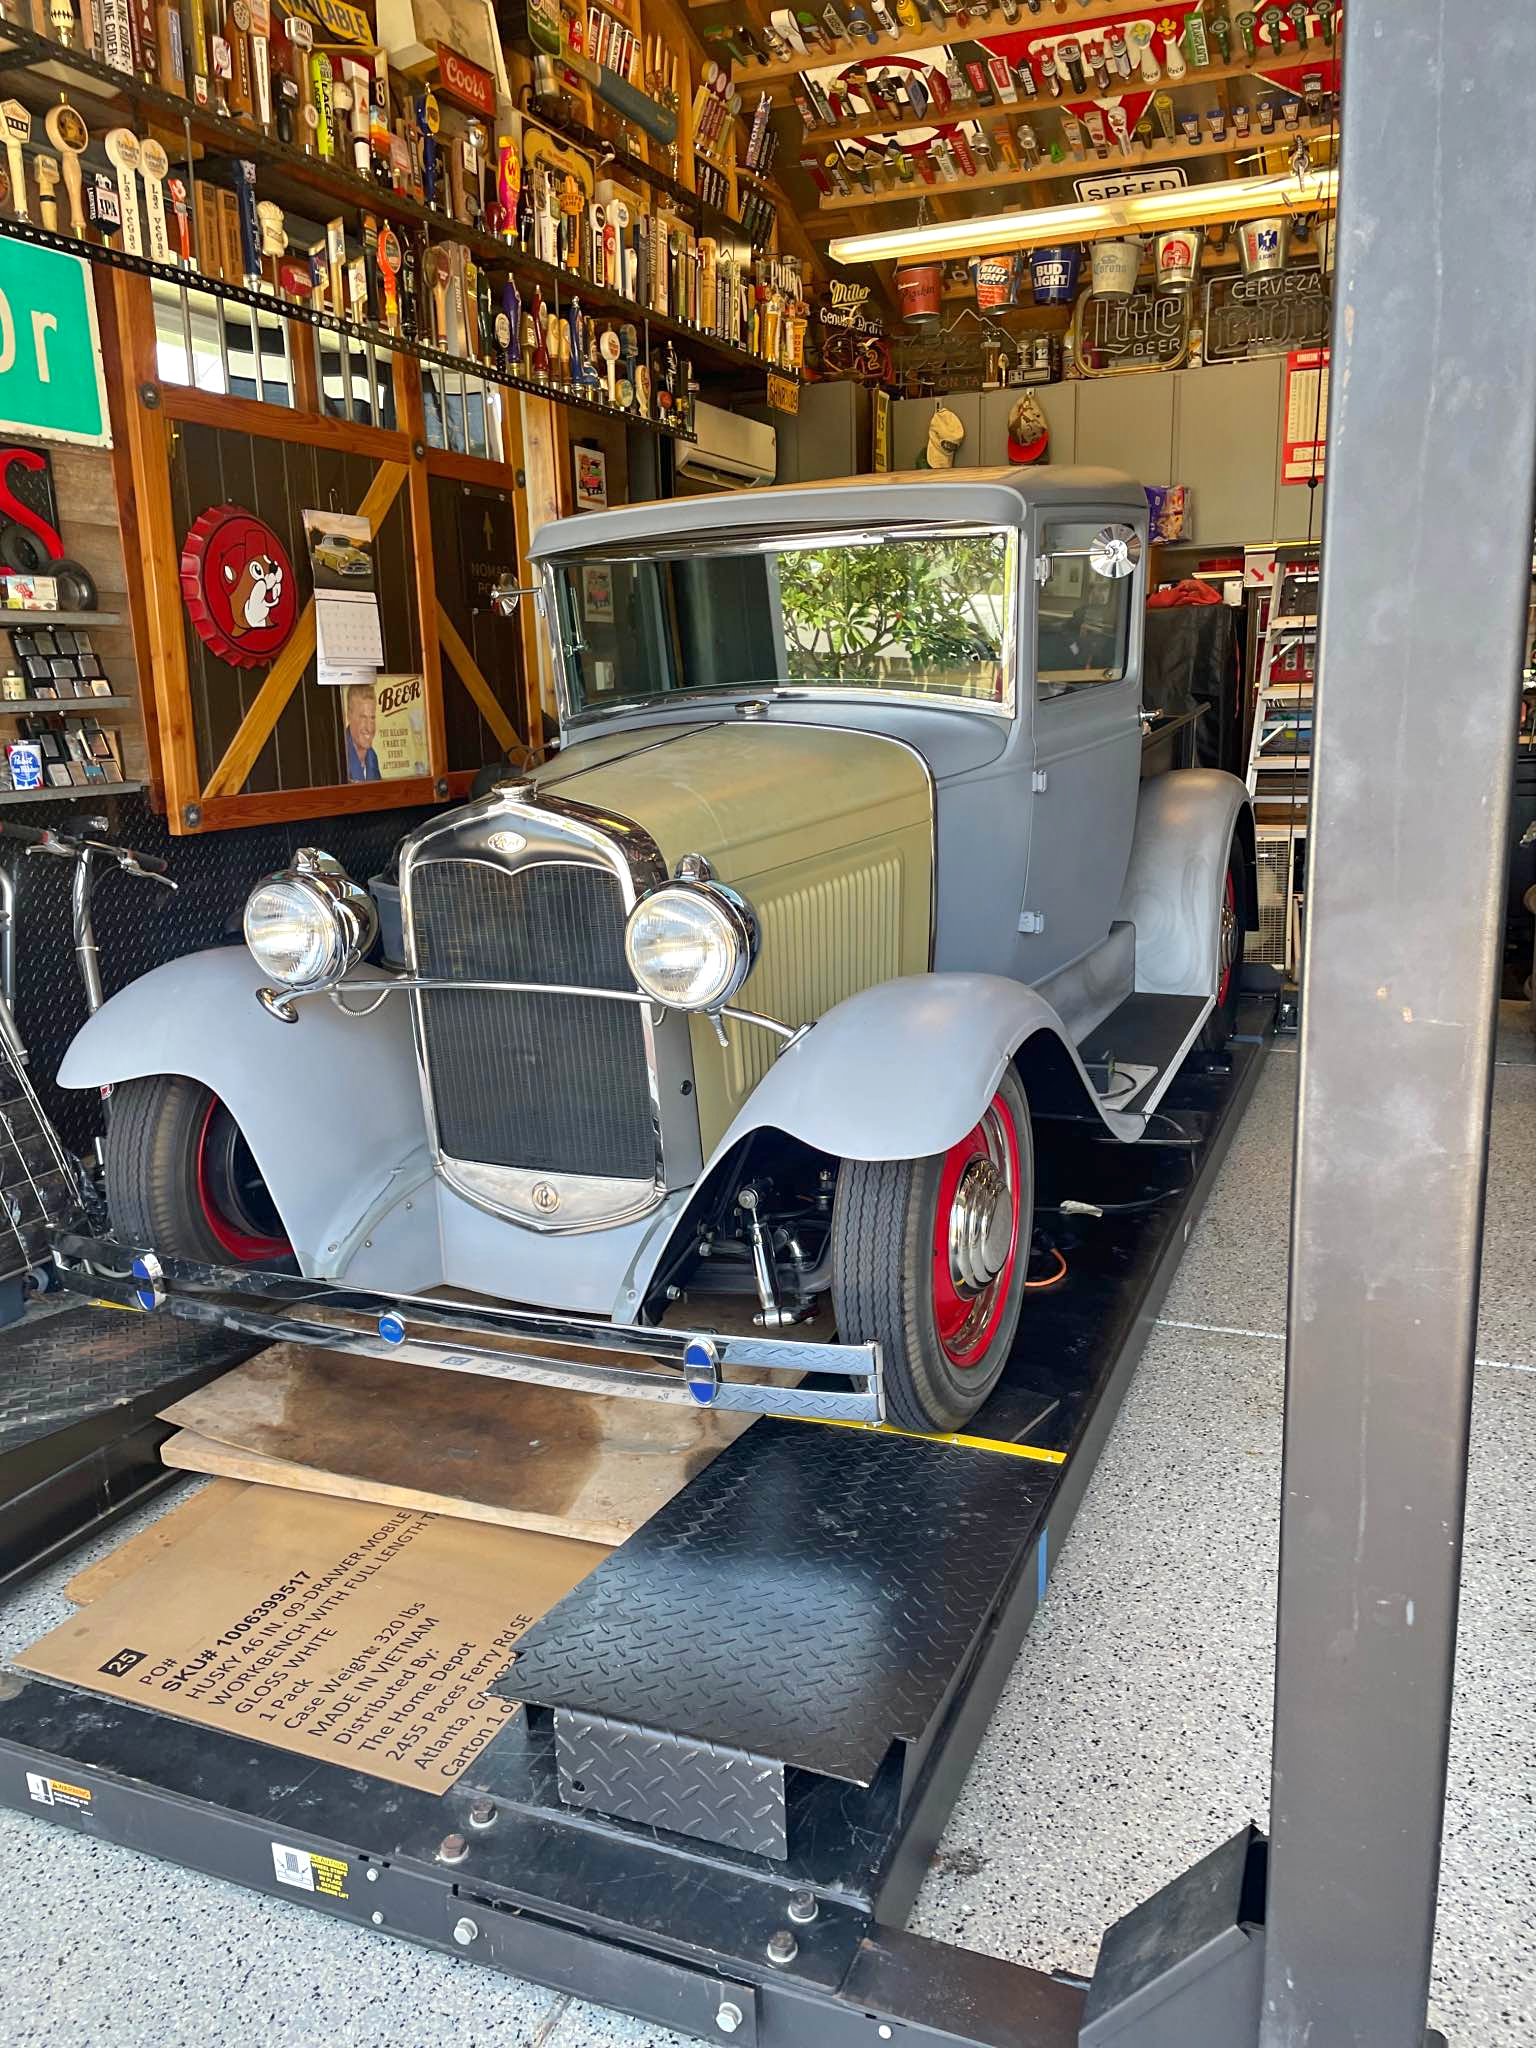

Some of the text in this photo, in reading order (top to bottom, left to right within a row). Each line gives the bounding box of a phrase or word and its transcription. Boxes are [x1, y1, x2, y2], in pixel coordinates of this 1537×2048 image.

[105, 23, 118, 57] CIDER
[119, 25, 131, 60] CIDER
[445, 56, 487, 101] Coors
[100, 198, 118, 217] IPA
[1087, 179, 1177, 201] SPEED
[978, 273, 1008, 283] LIGHT
[981, 264, 1007, 275] BUD
[1034, 274, 1067, 288] LIGHT
[1035, 263, 1063, 276] BUD
[1094, 262, 1128, 274] Corona
[830, 280, 871, 303] Miller
[1232, 273, 1321, 299] CERVEZA
[1092, 294, 1181, 354] Lite
[1133, 338, 1181, 356] BEER
[378, 681, 421, 713] BEER
[185, 1511, 412, 1699] HUSKY 46 IN. 09-DRAWER MOBILE
[208, 1624, 312, 1706] WORKBENCH
[305, 1590, 351, 1622] WITH
[344, 1563, 382, 1590] FULL
[375, 1521, 429, 1563] LENGTH
[162, 1570, 311, 1692] SKU# 1006399517
[108, 1652, 138, 1673] 25
[139, 1658, 178, 1685] PO#
[235, 1627, 338, 1714] GLOSS WHITE
[283, 1602, 426, 1729] Case Weight: 320 lbs
[307, 1617, 440, 1737] MADE IN VIETNAM
[259, 1677, 314, 1722] 1 Pack
[333, 1648, 440, 1745] Distributed By:
[358, 1641, 477, 1751] The Home Depot
[385, 1613, 533, 1761] 2455 Paces Ferry Rd SE
[414, 1714, 476, 1770] Atlanta,
[467, 1691, 489, 1710] GA
[441, 1727, 493, 1777] Carton
